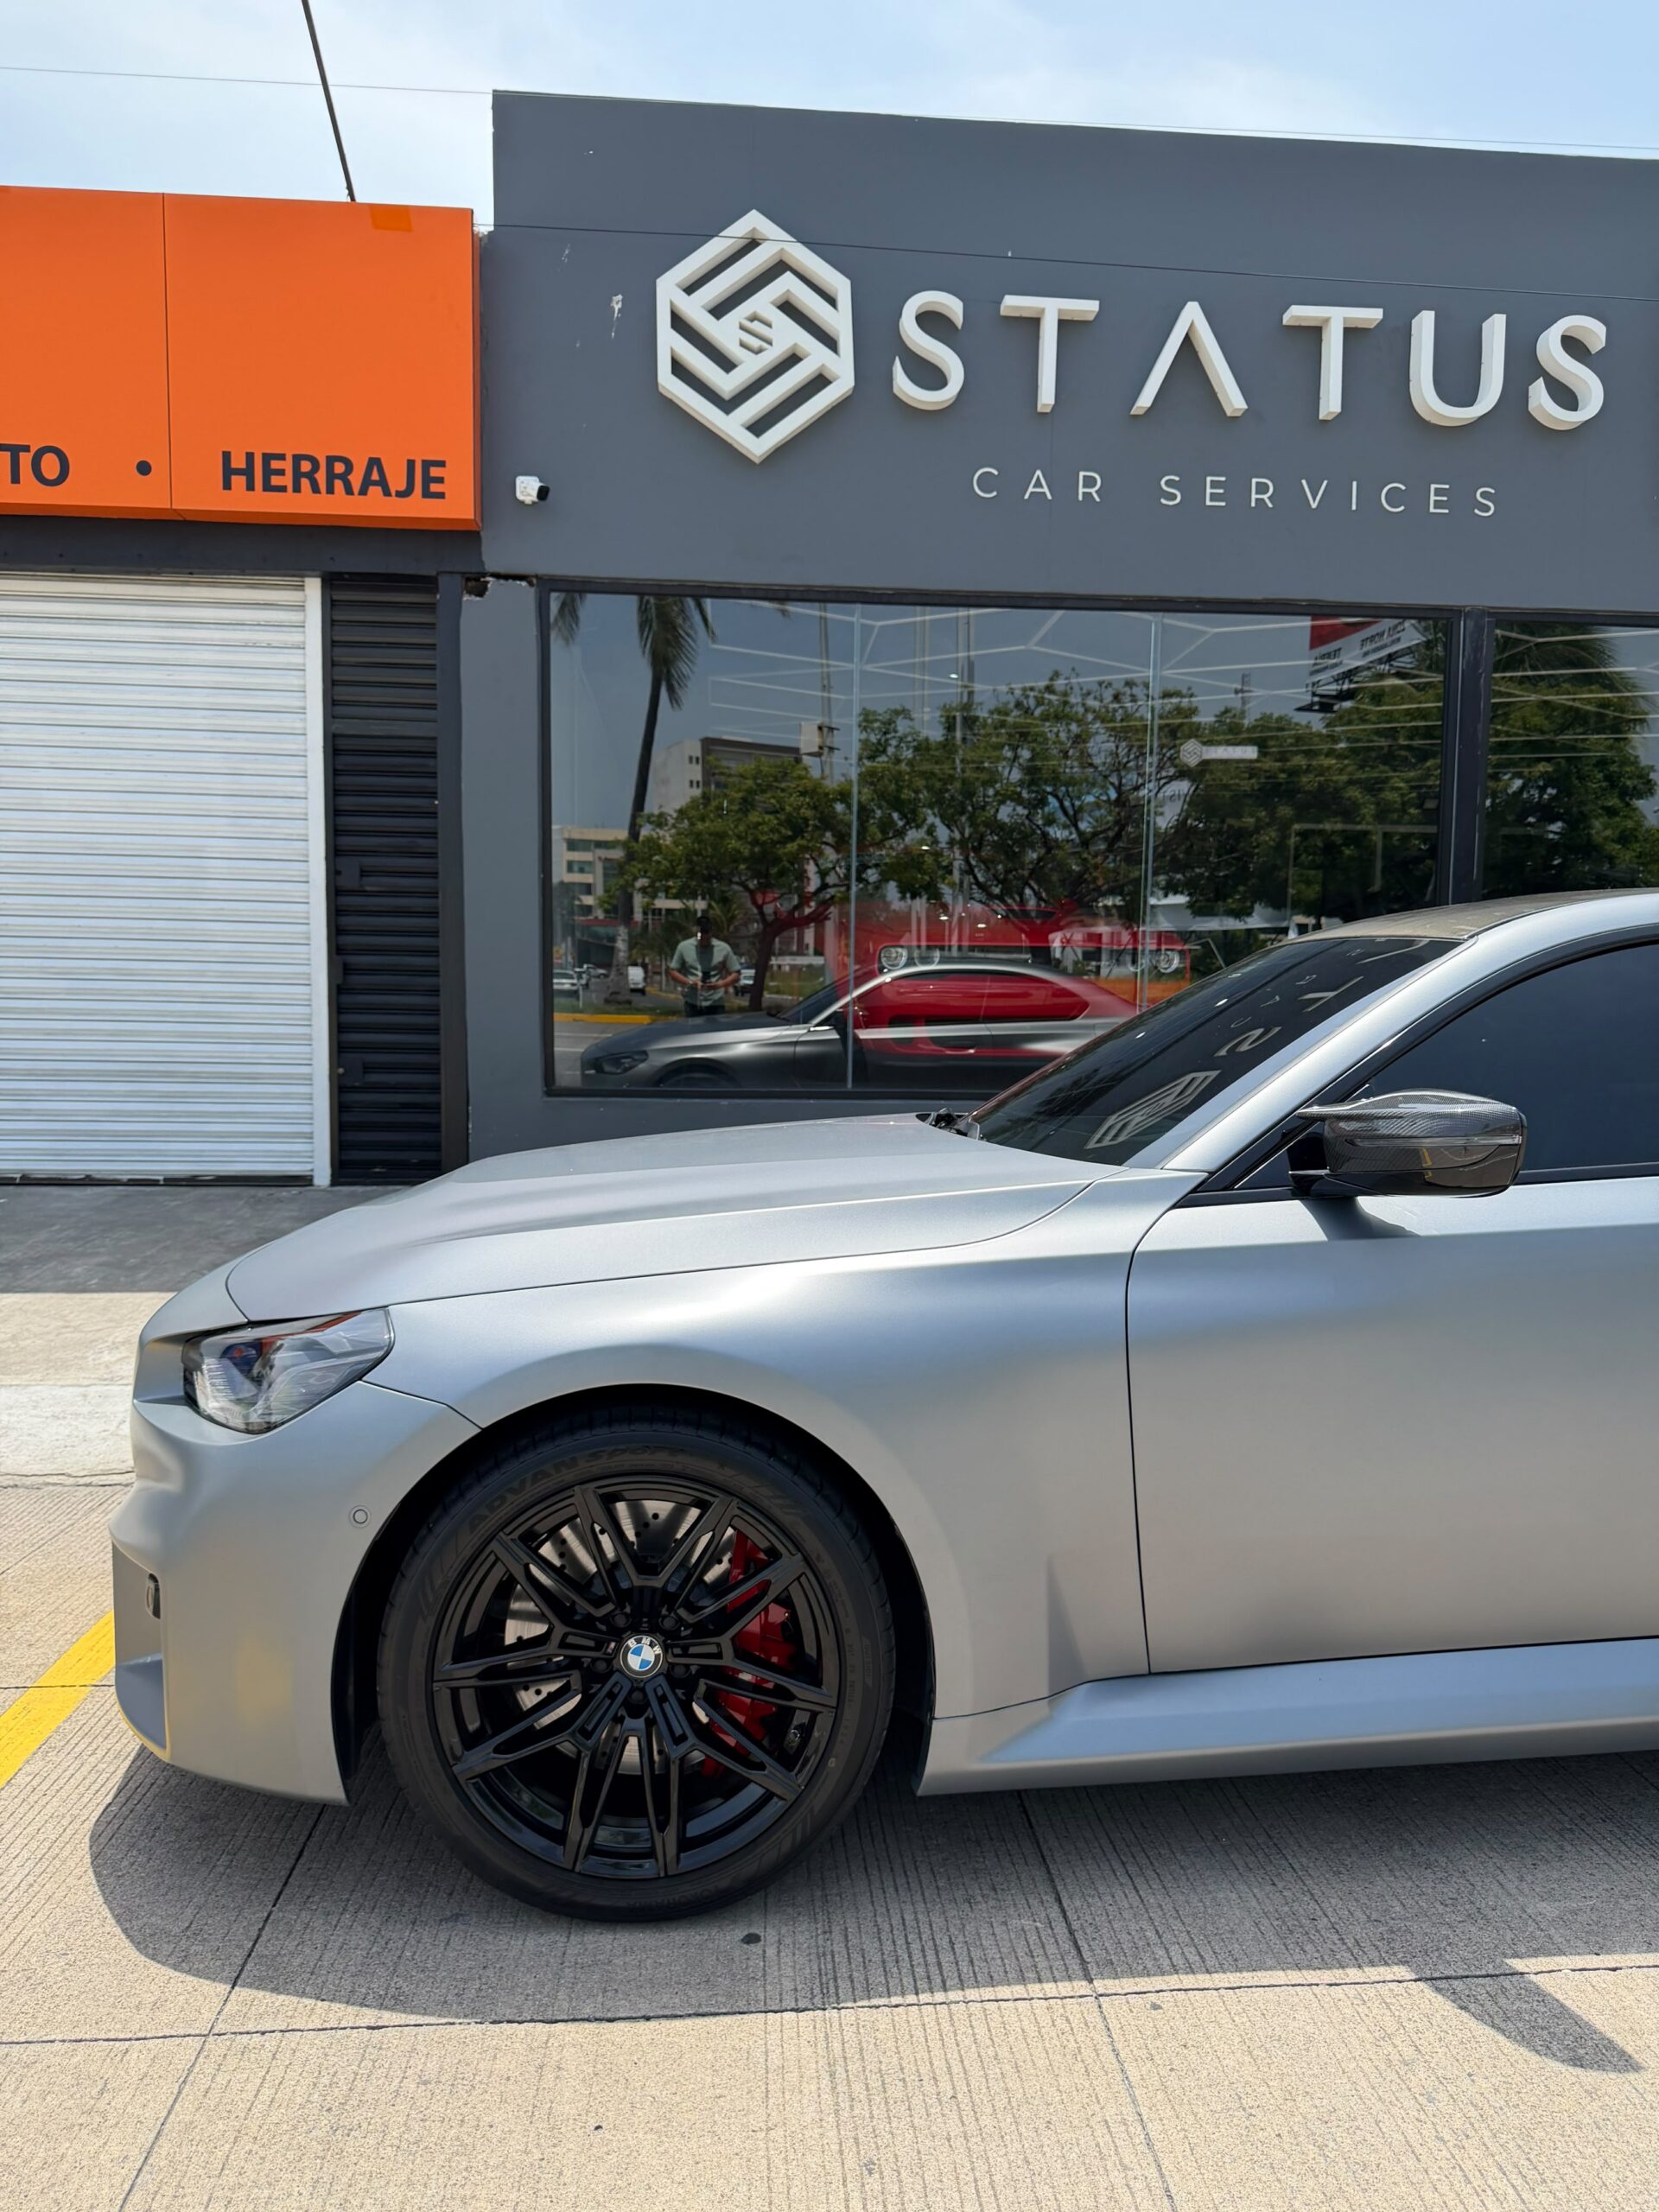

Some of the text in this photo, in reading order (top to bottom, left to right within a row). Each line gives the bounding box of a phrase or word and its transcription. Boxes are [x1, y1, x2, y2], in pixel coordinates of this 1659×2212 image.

[892, 289, 1607, 431] STATUS
[0, 442, 447, 499] TO HERRAJE
[971, 467, 1497, 518] CAR SERVICES
[467, 1455, 581, 1535] ADVAN
[626, 1636, 663, 1656] BMW
